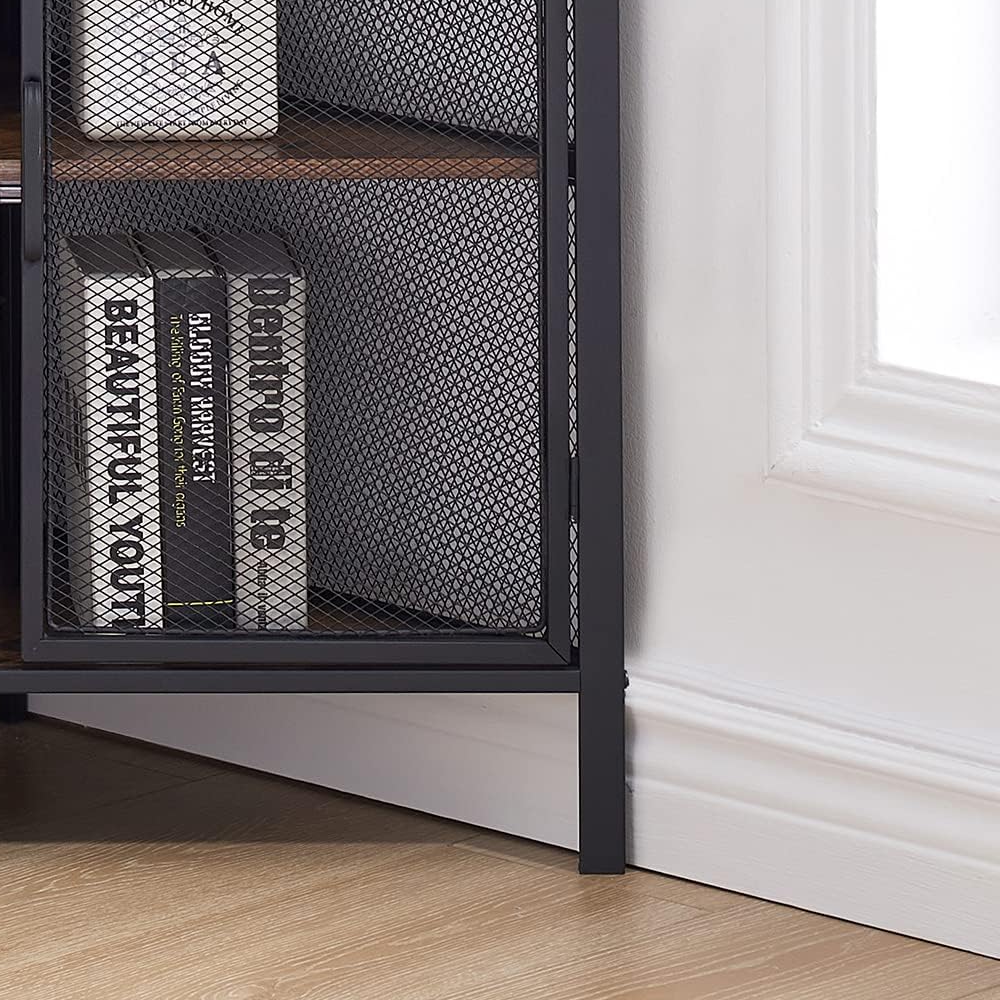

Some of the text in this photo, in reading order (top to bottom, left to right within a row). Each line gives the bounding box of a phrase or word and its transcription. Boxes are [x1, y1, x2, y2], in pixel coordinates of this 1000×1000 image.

[201, 0, 246, 34] HOME
[104, 300, 143, 504] BEAUTIFUL
[170, 372, 186, 383] of
[188, 312, 215, 484] BLOODY HARVEST
[247, 278, 291, 433] Dentro
[250, 507, 291, 550] te
